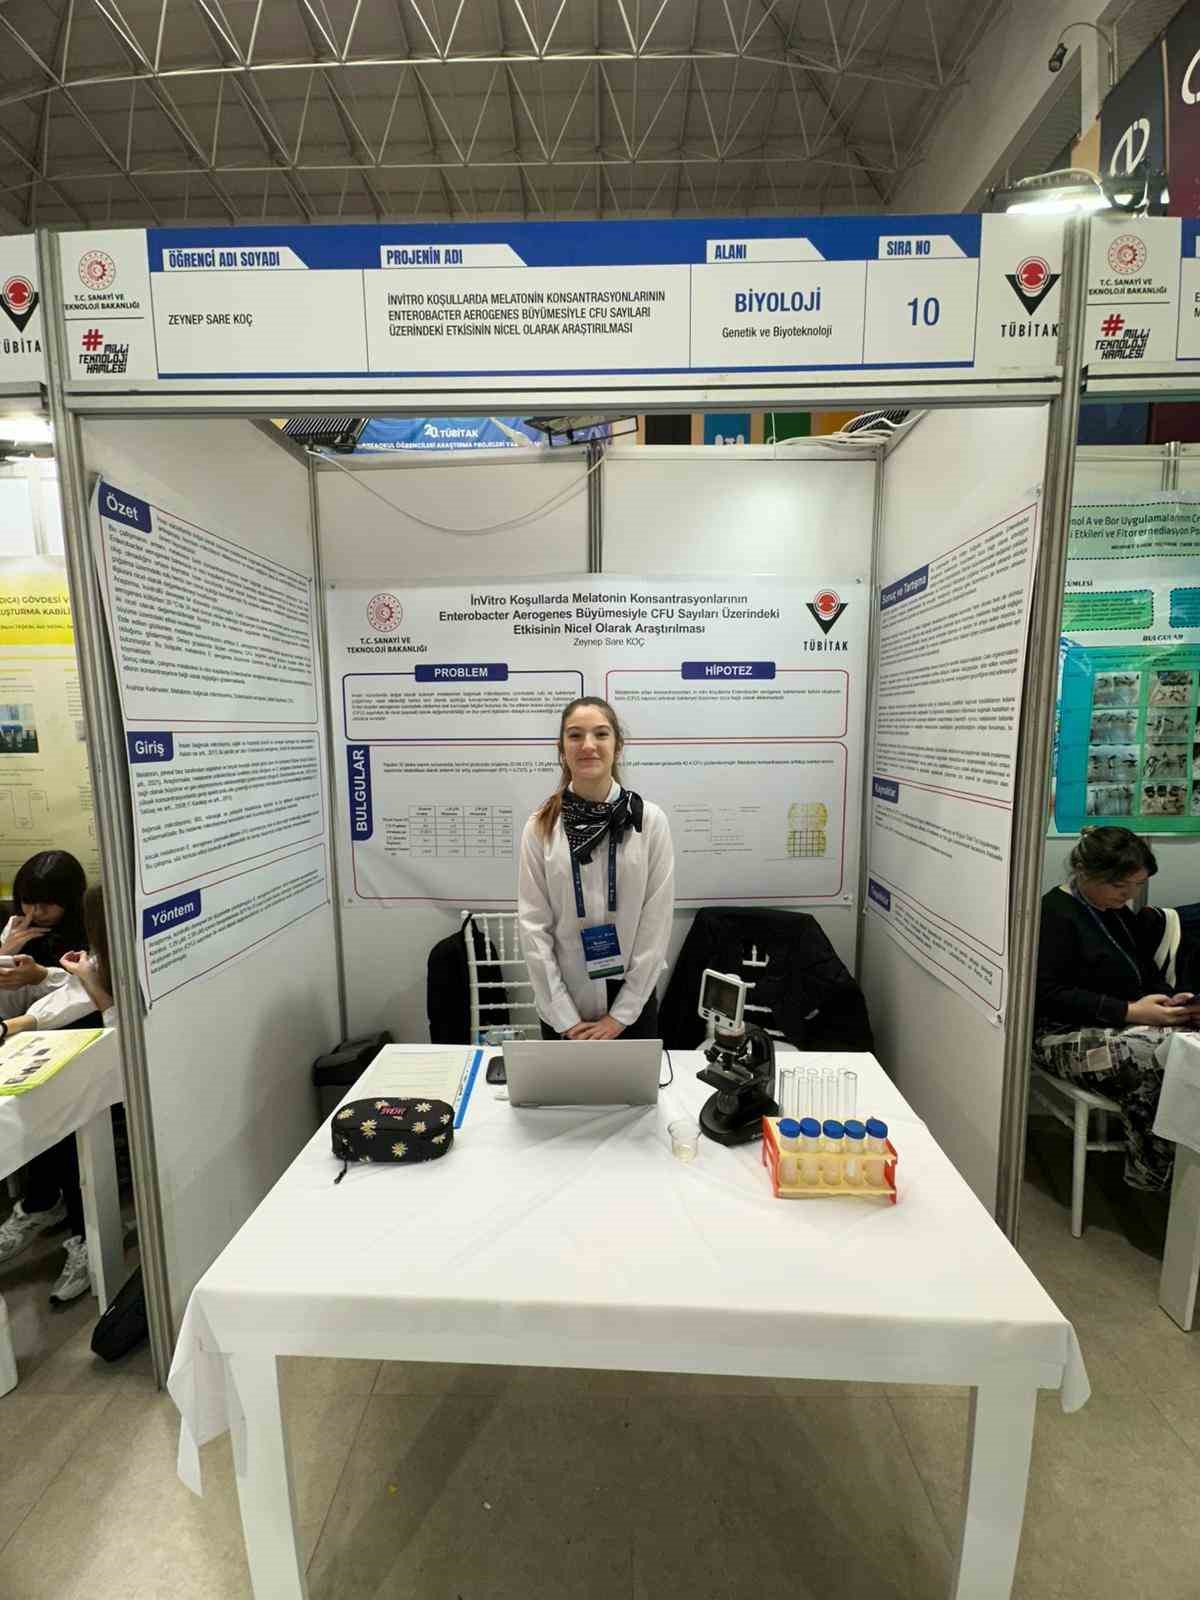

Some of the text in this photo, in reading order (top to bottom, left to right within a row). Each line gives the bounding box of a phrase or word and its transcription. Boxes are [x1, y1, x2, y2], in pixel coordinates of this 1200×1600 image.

[714, 243, 747, 260] ALANI
[886, 240, 931, 256] SIRA NO
[168, 249, 280, 268] ÖĞRENCİ ADI SOYADI
[386, 246, 463, 265] PROJENİN ADI
[1115, 278, 1141, 286] SANAYİ
[88, 292, 114, 301] SANAYİ
[1127, 286, 1167, 294] BAKANLIĞI
[101, 301, 140, 309] BAKANLIĞI
[387, 290, 665, 308] İNVİTRO KOŞULLARDA MELATONİN KONSANTRASYONLARININ
[734, 286, 822, 313] BİYOLOJİ
[388, 305, 650, 321] ENTEROBACTER AEROGENES BÜYÜMESİYLE CFU SAYILARI
[907, 297, 940, 327] 10
[168, 313, 253, 327] ZEYNEP SARE KOÇ
[389, 320, 633, 337] ÜZERİNDEKİ ETKİSİNİN NİCEL OLARAK ARAŞTIRILMASI
[722, 325, 833, 339] Genetik ve Biyoteknoloji
[1001, 321, 1058, 337] TÜBİTAK
[2, 338, 42, 354] ÜBİTA
[440, 427, 479, 438] TÜBİTAK
[106, 492, 139, 521] Özet
[1105, 516, 1120, 525] Bor
[1075, 528, 1103, 539] Etkileri
[1105, 530, 1115, 538] ve
[470, 592, 748, 607] İnVitro Koşullarda Melatonin Konsantrasyonlarının
[0, 606, 71, 616] UŞTURMA KABİLİ
[439, 606, 780, 622] Enterobacter Aerogenes Büyümesiyle CFU Sayıları Üzerindeki
[513, 622, 705, 636] Etkisinin Nicel Olarak Araştırılması
[360, 637, 374, 645] T.C.
[374, 636, 400, 645] SANAYİ
[573, 637, 646, 649] Zeynep Sare KOÇ
[803, 639, 848, 651] TÜBİTAK
[347, 644, 428, 654] TEKNOLOJİ BAKANLIĞI
[434, 667, 488, 678] PROBLEM
[705, 664, 753, 676] HİPOTEZ
[135, 740, 165, 758] Giriş
[352, 749, 368, 832] BULGULAR
[151, 901, 194, 926] Yöntem
